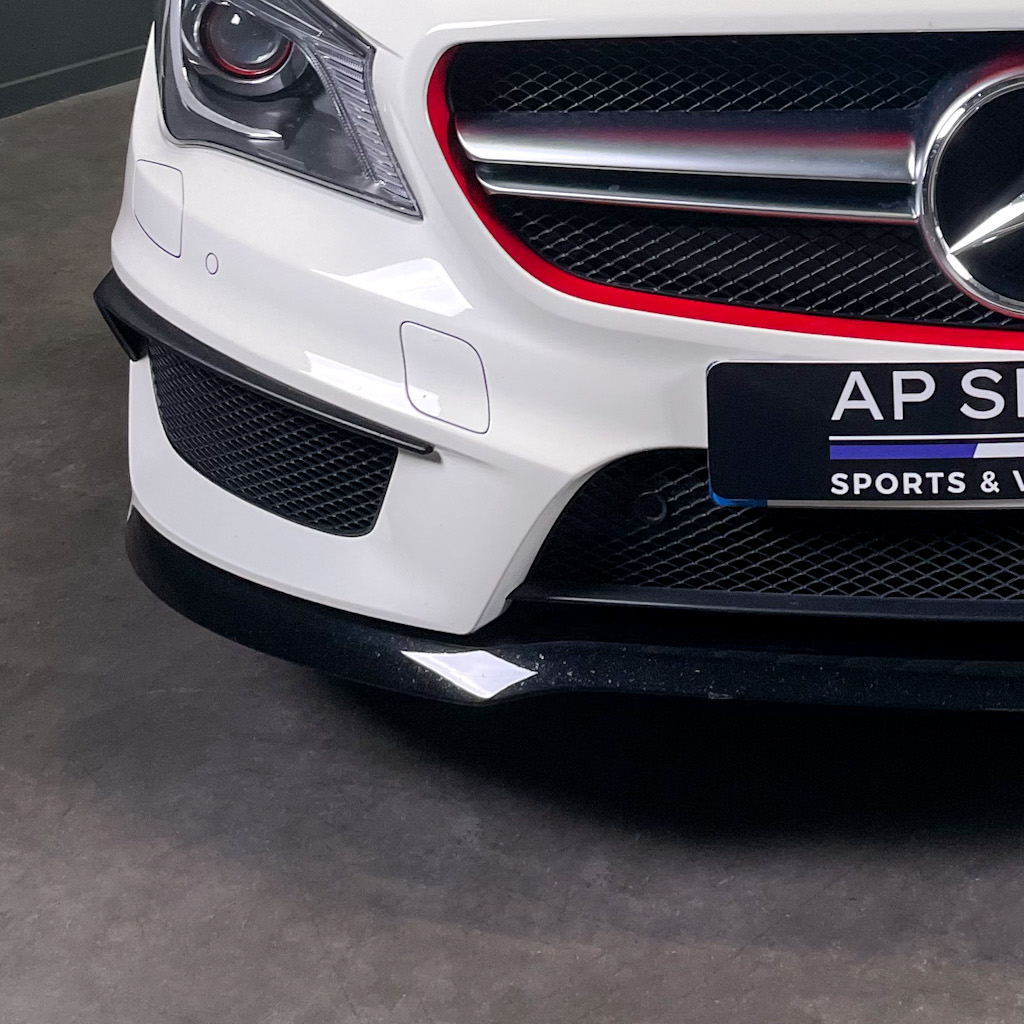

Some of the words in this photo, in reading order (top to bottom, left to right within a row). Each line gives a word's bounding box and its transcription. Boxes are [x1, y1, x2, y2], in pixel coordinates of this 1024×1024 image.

[830, 369, 936, 421] AP
[830, 471, 966, 496] SPORTS
[980, 470, 1000, 493] &
